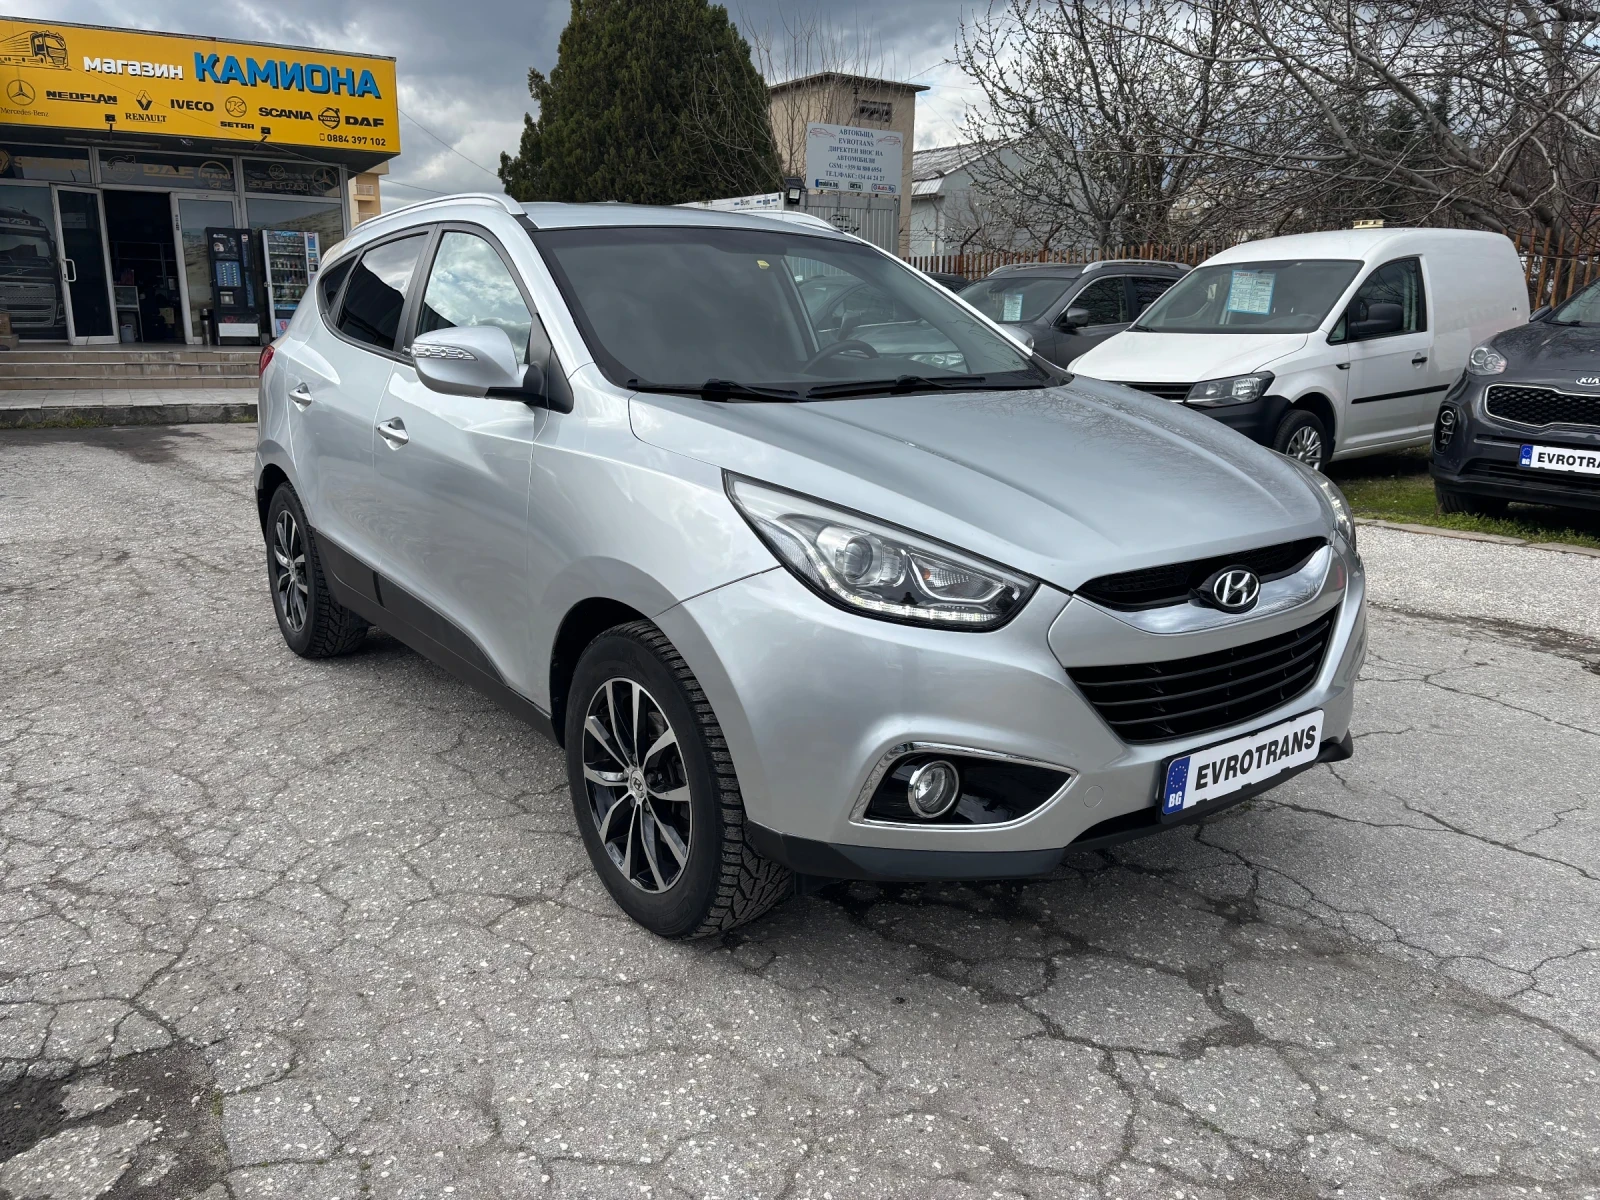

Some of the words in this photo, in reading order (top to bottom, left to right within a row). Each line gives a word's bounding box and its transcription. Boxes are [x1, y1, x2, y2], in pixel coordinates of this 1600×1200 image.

[83, 56, 183, 80] магазин
[194, 52, 382, 99] КАМИОНА
[46, 90, 118, 104] NEOPLAN
[170, 99, 215, 112] IVECO
[0, 107, 49, 117] Mercedes-Benz
[125, 112, 167, 123] RENAULT
[258, 107, 314, 121] SCANIA
[220, 121, 255, 130] SETRA
[345, 116, 384, 127] DAF
[839, 128, 874, 138] АВТОКЪЩА
[327, 133, 349, 143] 0884
[351, 135, 368, 145] 397
[370, 137, 386, 146] 102
[838, 138, 875, 147] EVROTRANS
[143, 164, 194, 175] DAF
[202, 172, 228, 180] MAN
[1537, 452, 1600, 469] EVROTR
[1168, 791, 1183, 808] BG
[1195, 725, 1317, 791] EVROTRANS
